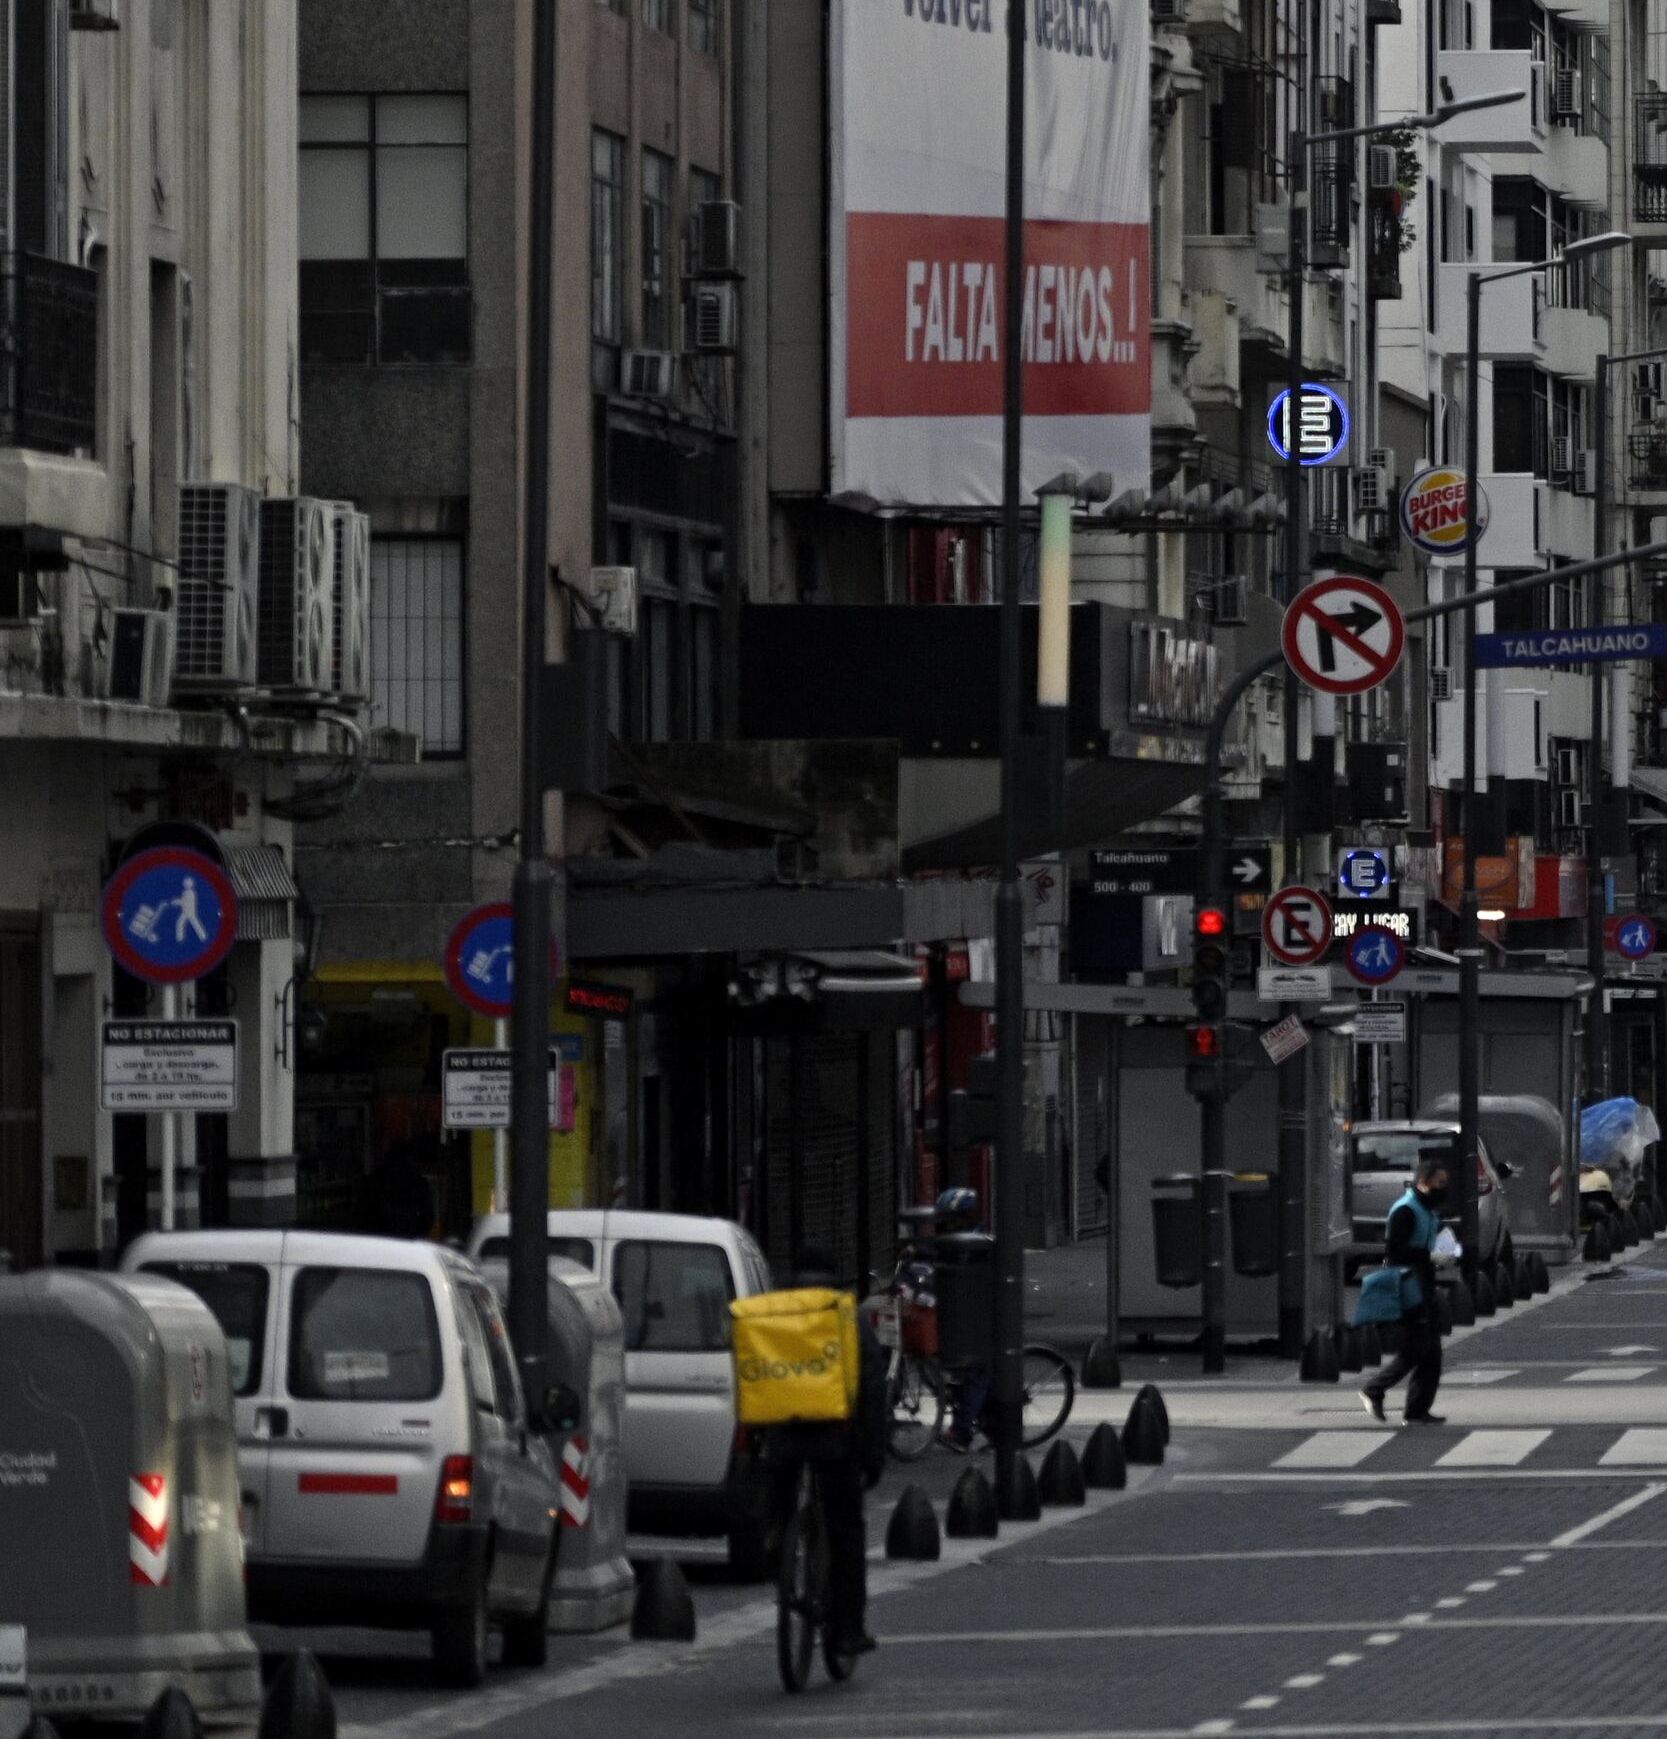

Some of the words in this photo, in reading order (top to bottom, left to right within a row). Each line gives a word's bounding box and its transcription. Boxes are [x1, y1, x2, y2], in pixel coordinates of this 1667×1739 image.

[905, 260, 999, 363] FALTA
[1500, 633, 1648, 659] TALCAHUANO
[1094, 852, 1168, 865] Talcahuano
[108, 1027, 132, 1042] NO
[136, 1027, 229, 1043] ESTACIONAR
[449, 1056, 468, 1069] NO
[471, 1056, 511, 1069] ESTAC
[738, 1354, 828, 1386] Glovo
